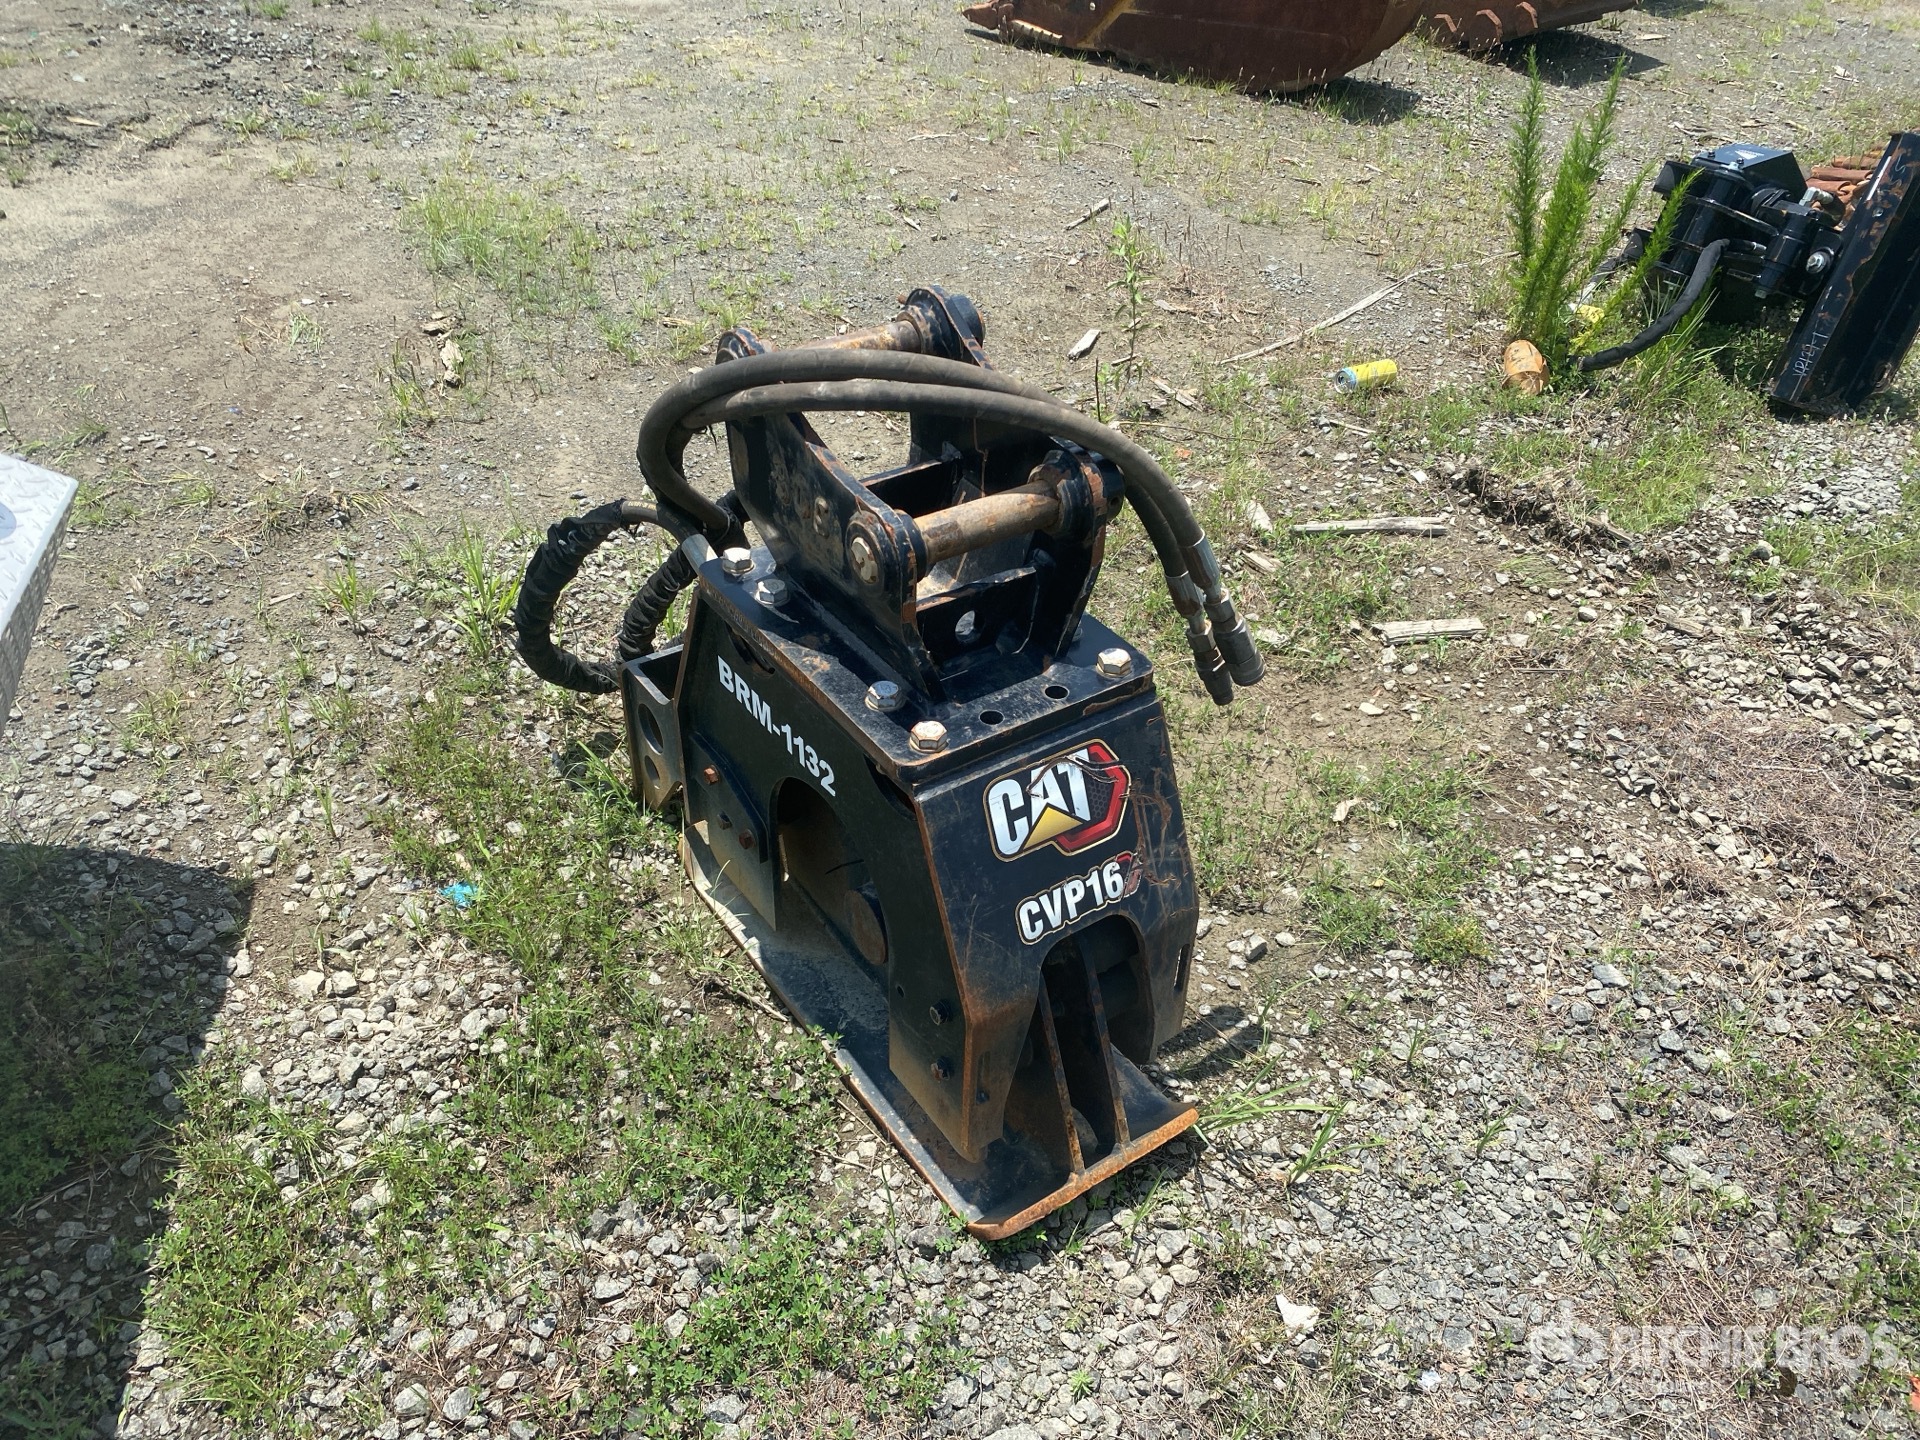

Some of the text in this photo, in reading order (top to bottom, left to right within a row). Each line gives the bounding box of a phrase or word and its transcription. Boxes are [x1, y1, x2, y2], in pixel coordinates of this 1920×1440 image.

[717, 655, 836, 797] BRM-1132
[988, 748, 1091, 855] CAT
[1018, 861, 1124, 940] CVP16
